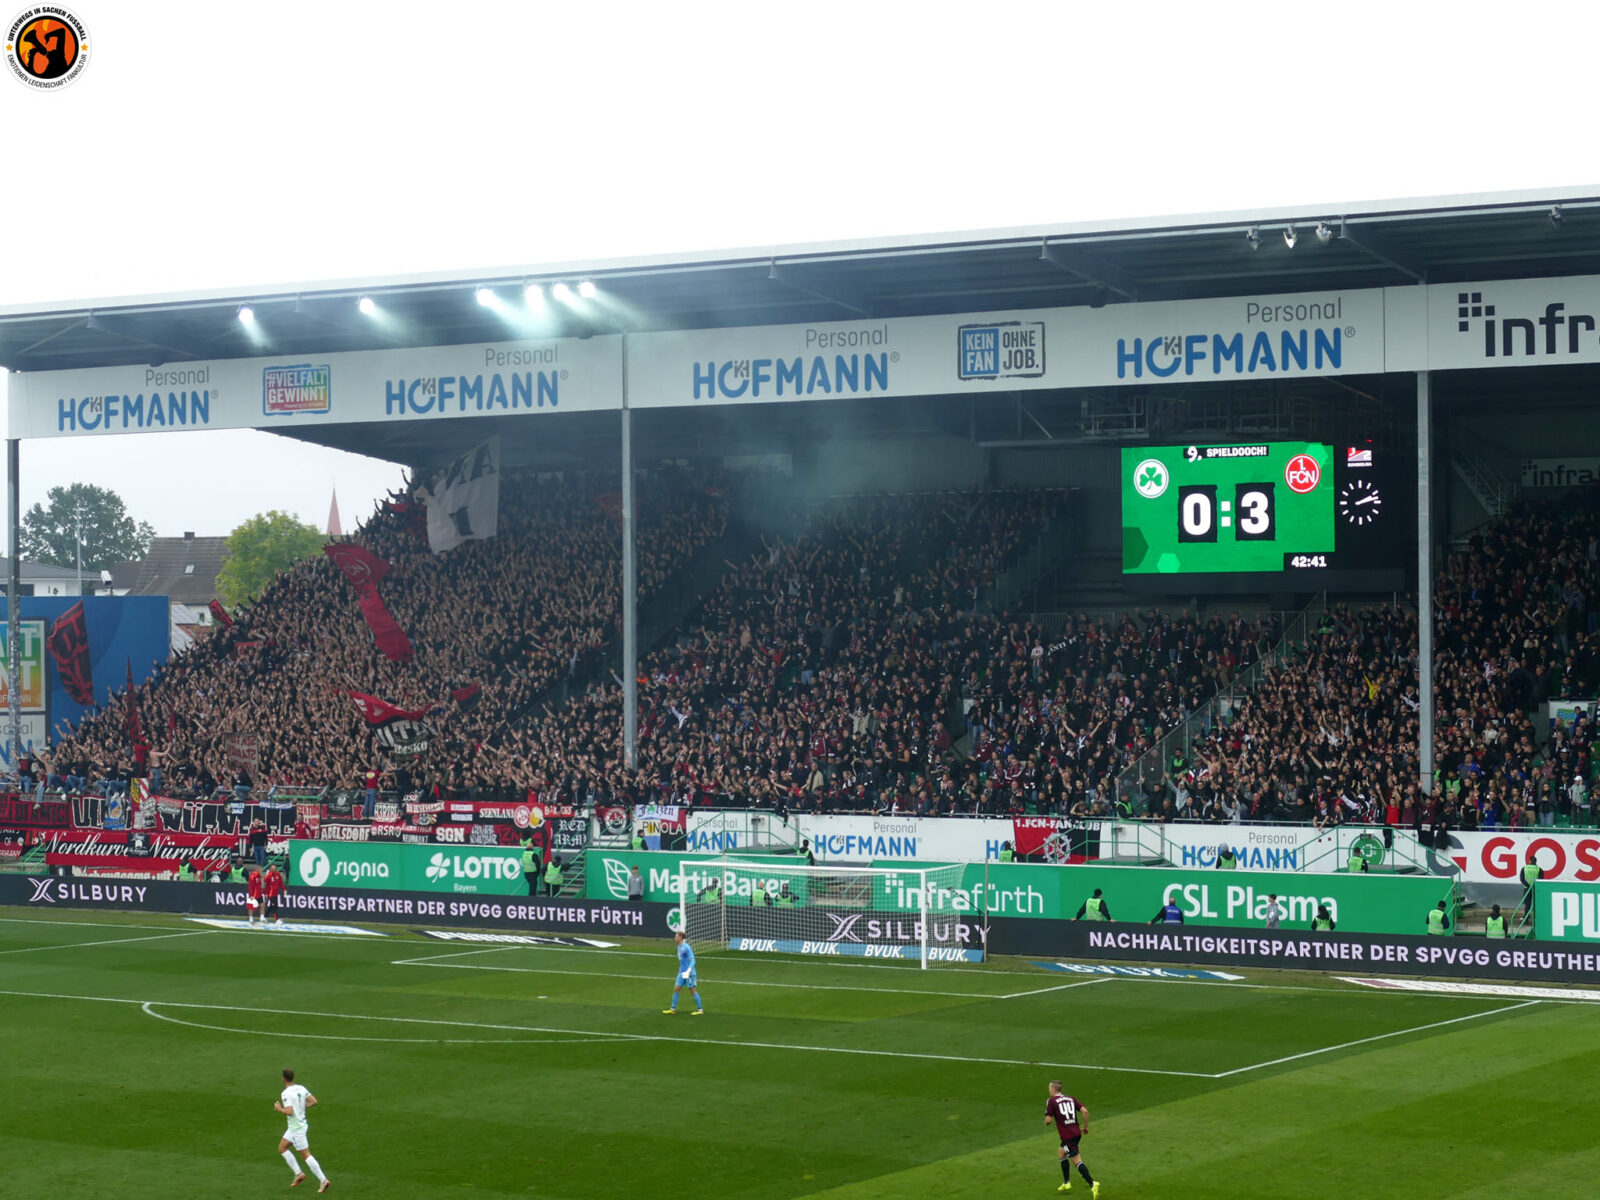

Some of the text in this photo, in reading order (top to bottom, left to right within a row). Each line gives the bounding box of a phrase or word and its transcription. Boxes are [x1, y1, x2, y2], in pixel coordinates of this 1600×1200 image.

[1247, 296, 1342, 324] Personal
[805, 324, 889, 349] Personal
[966, 332, 995, 350] KEIN
[1002, 330, 1036, 348] OHNE
[1485, 302, 1600, 358] infr
[485, 344, 559, 368] Personal
[966, 350, 995, 372] FAN
[1002, 348, 1040, 370] JOB.
[1117, 327, 1342, 379] HOFMANN
[145, 365, 210, 387] Personal
[267, 370, 327, 388] #VIELFALT
[693, 351, 889, 400] HOFMANN
[268, 385, 326, 404] GEWINNT
[385, 370, 559, 416] HOFMANN
[58, 389, 210, 432] HOFMANN
[1186, 445, 1268, 463] 9. SPIELDOOCH!
[1289, 470, 1316, 485] FCN
[1291, 555, 1328, 568] 42:41
[642, 821, 684, 836] PINOLA
[697, 817, 738, 829] Personal
[873, 821, 917, 834] Personal
[436, 827, 465, 843] SGN
[1248, 831, 1298, 845] Personal
[453, 855, 521, 881] LOTTO
[1182, 845, 1298, 870] HOMANN
[334, 860, 390, 882] signia
[58, 883, 147, 903] SILBURY
[453, 883, 477, 893] Bayern
[418, 901, 446, 916] DER
[450, 902, 502, 919] SPVGG
[506, 905, 587, 922] GREUTHER
[591, 906, 644, 926] FÜRTH
[1163, 883, 1338, 923] CSL Plasma
[1089, 931, 1363, 960] NACHHALTIGKEITSPARTNER
[1370, 945, 1409, 962] DER
[1416, 946, 1490, 966] SPVGG
[1058, 1101, 1076, 1120] 44
